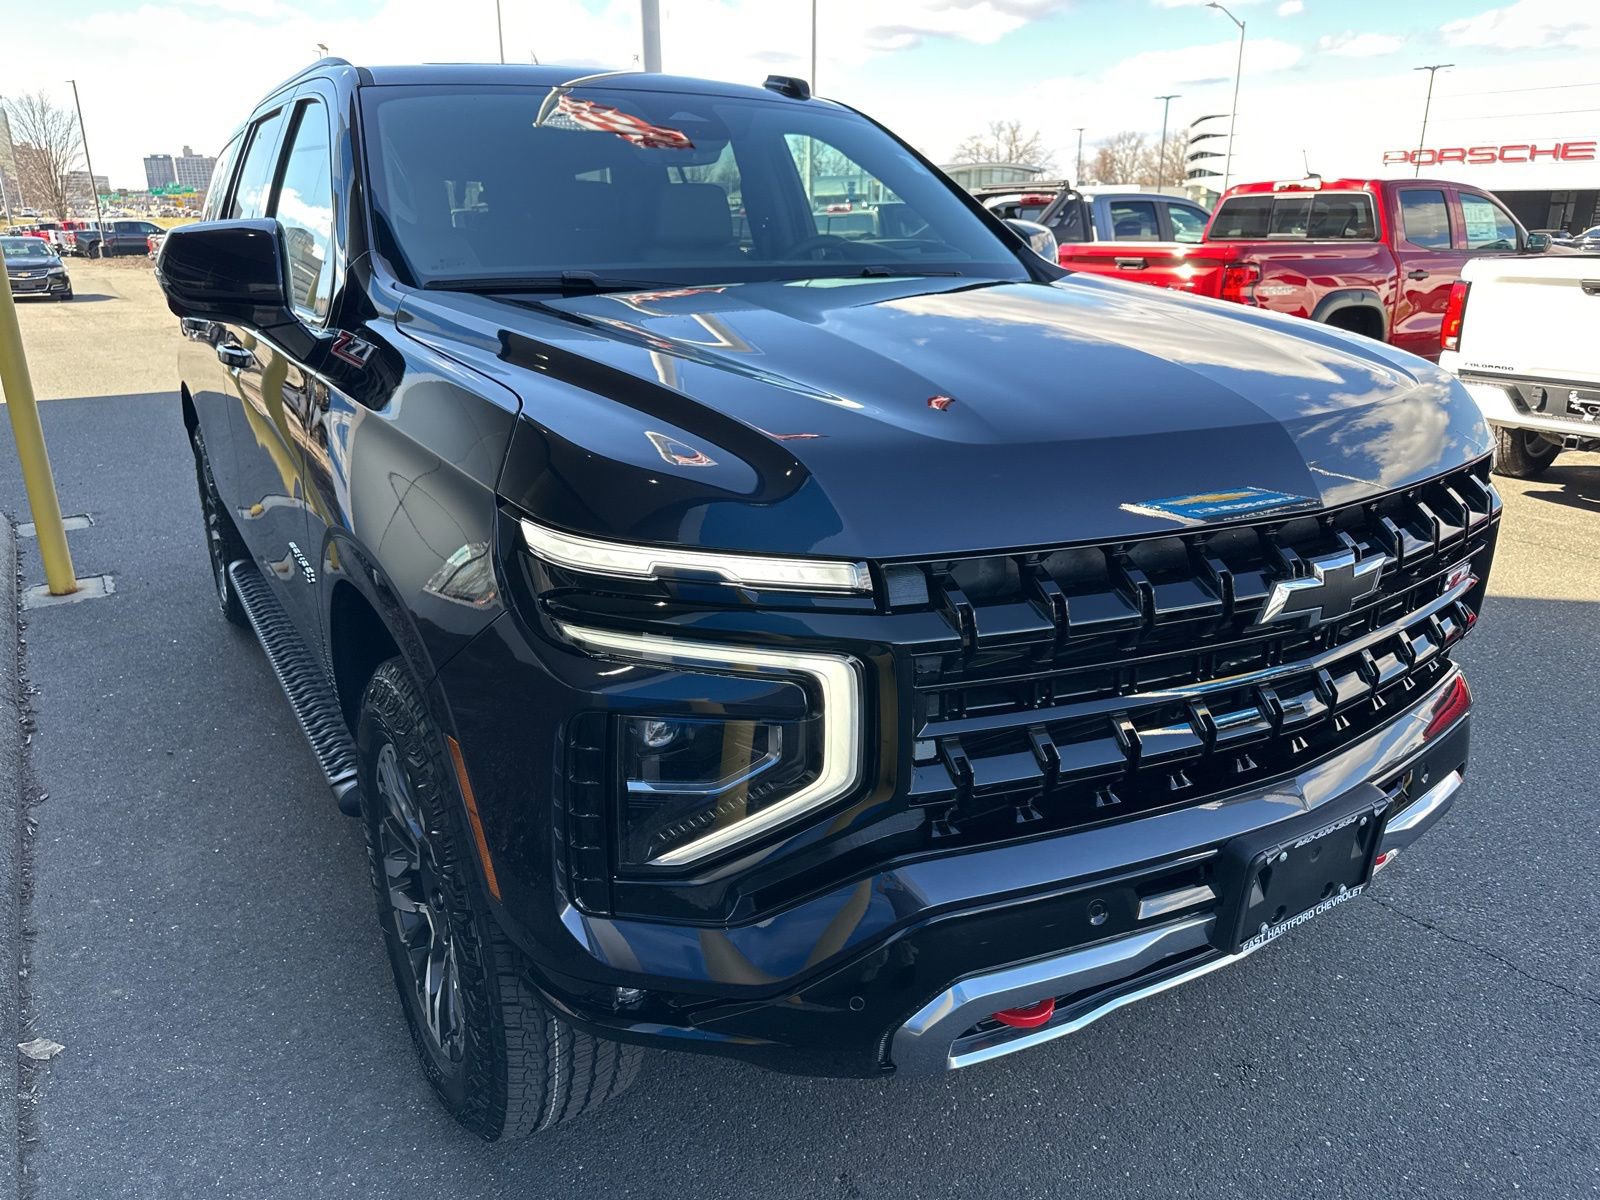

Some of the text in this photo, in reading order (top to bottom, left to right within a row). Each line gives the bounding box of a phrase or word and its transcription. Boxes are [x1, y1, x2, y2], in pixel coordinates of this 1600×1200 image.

[1383, 141, 1597, 166] PORSCHE
[331, 329, 380, 369] Z71
[1242, 886, 1364, 952] EAST HARTFORD CHEVROLET
